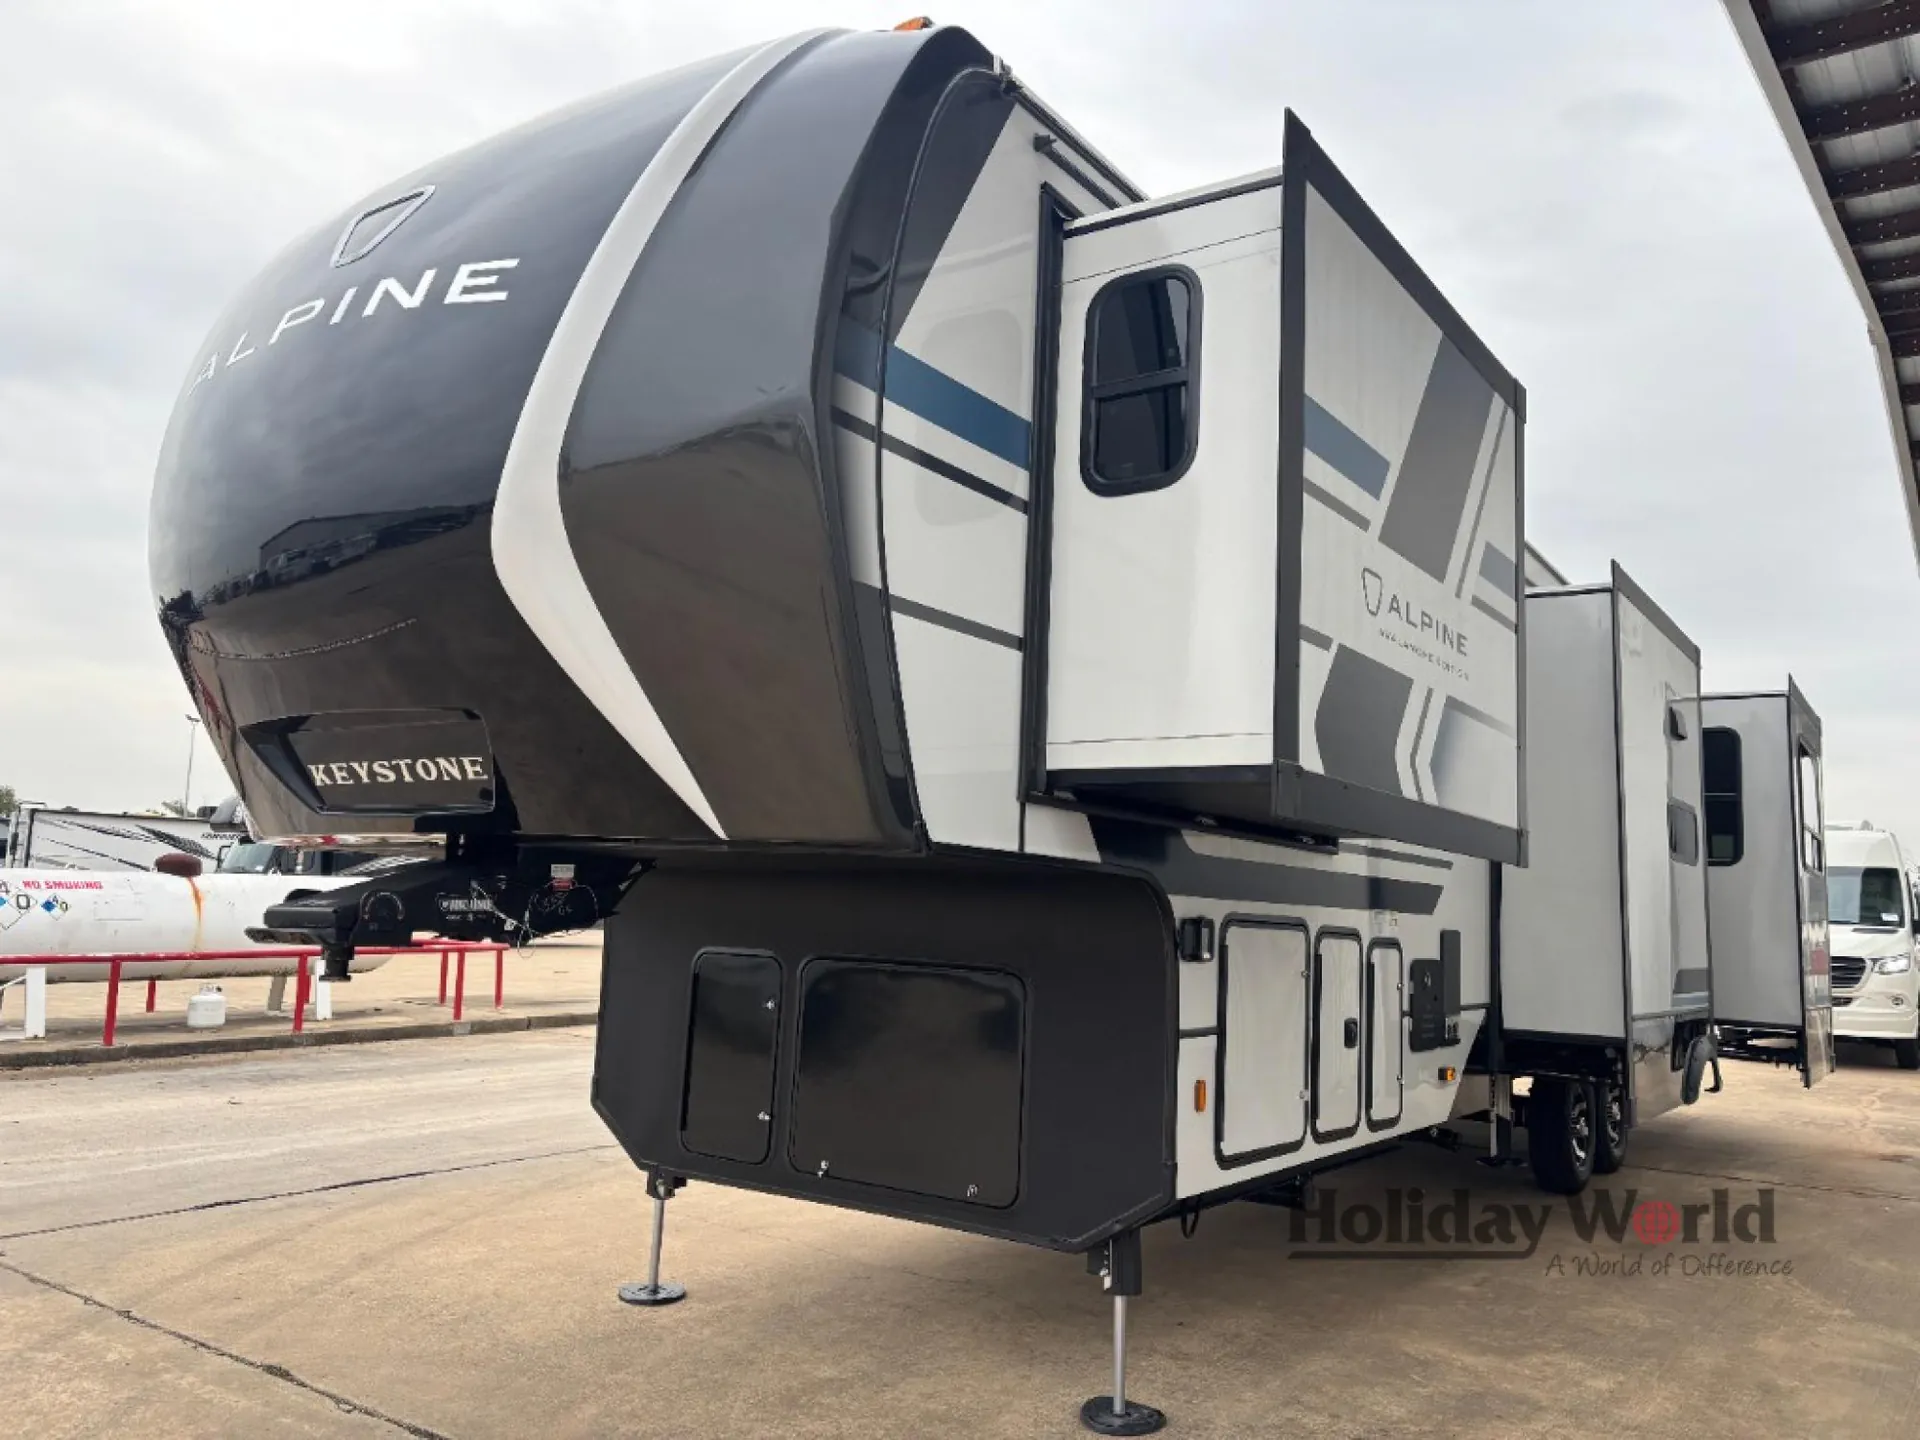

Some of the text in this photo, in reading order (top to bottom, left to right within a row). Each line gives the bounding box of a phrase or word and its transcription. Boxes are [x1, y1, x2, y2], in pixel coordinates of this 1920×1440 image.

[187, 257, 521, 396] ALPINE
[1388, 594, 1467, 656] ALPINE
[307, 756, 489, 787] KEYSTONE
[22, 880, 103, 890] NO SMOKING
